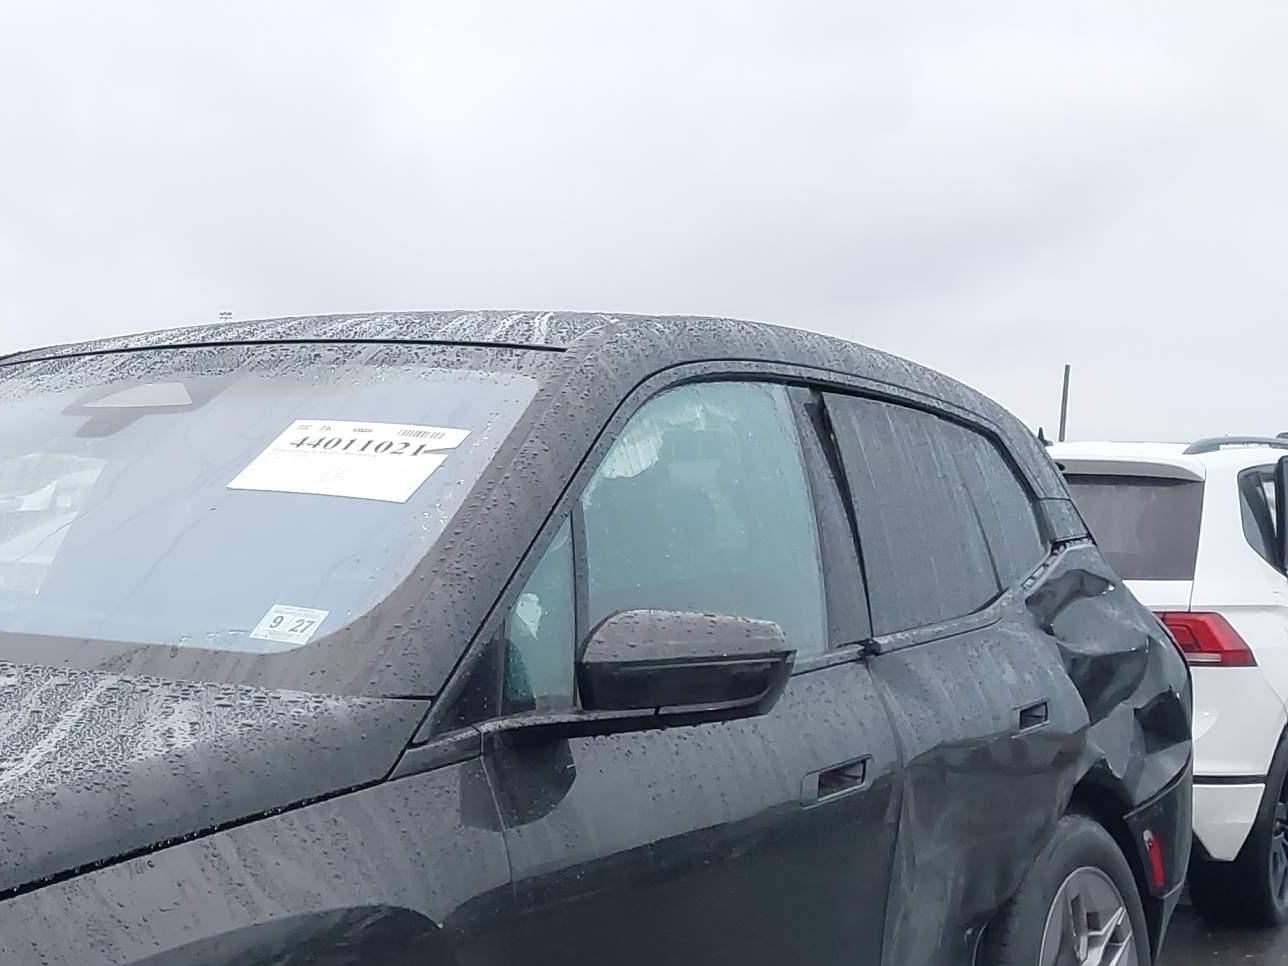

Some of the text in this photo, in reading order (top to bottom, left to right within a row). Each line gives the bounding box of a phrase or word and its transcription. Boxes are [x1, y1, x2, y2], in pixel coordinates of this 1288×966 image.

[289, 435, 428, 457] 44011021
[269, 615, 316, 634] 9 27
